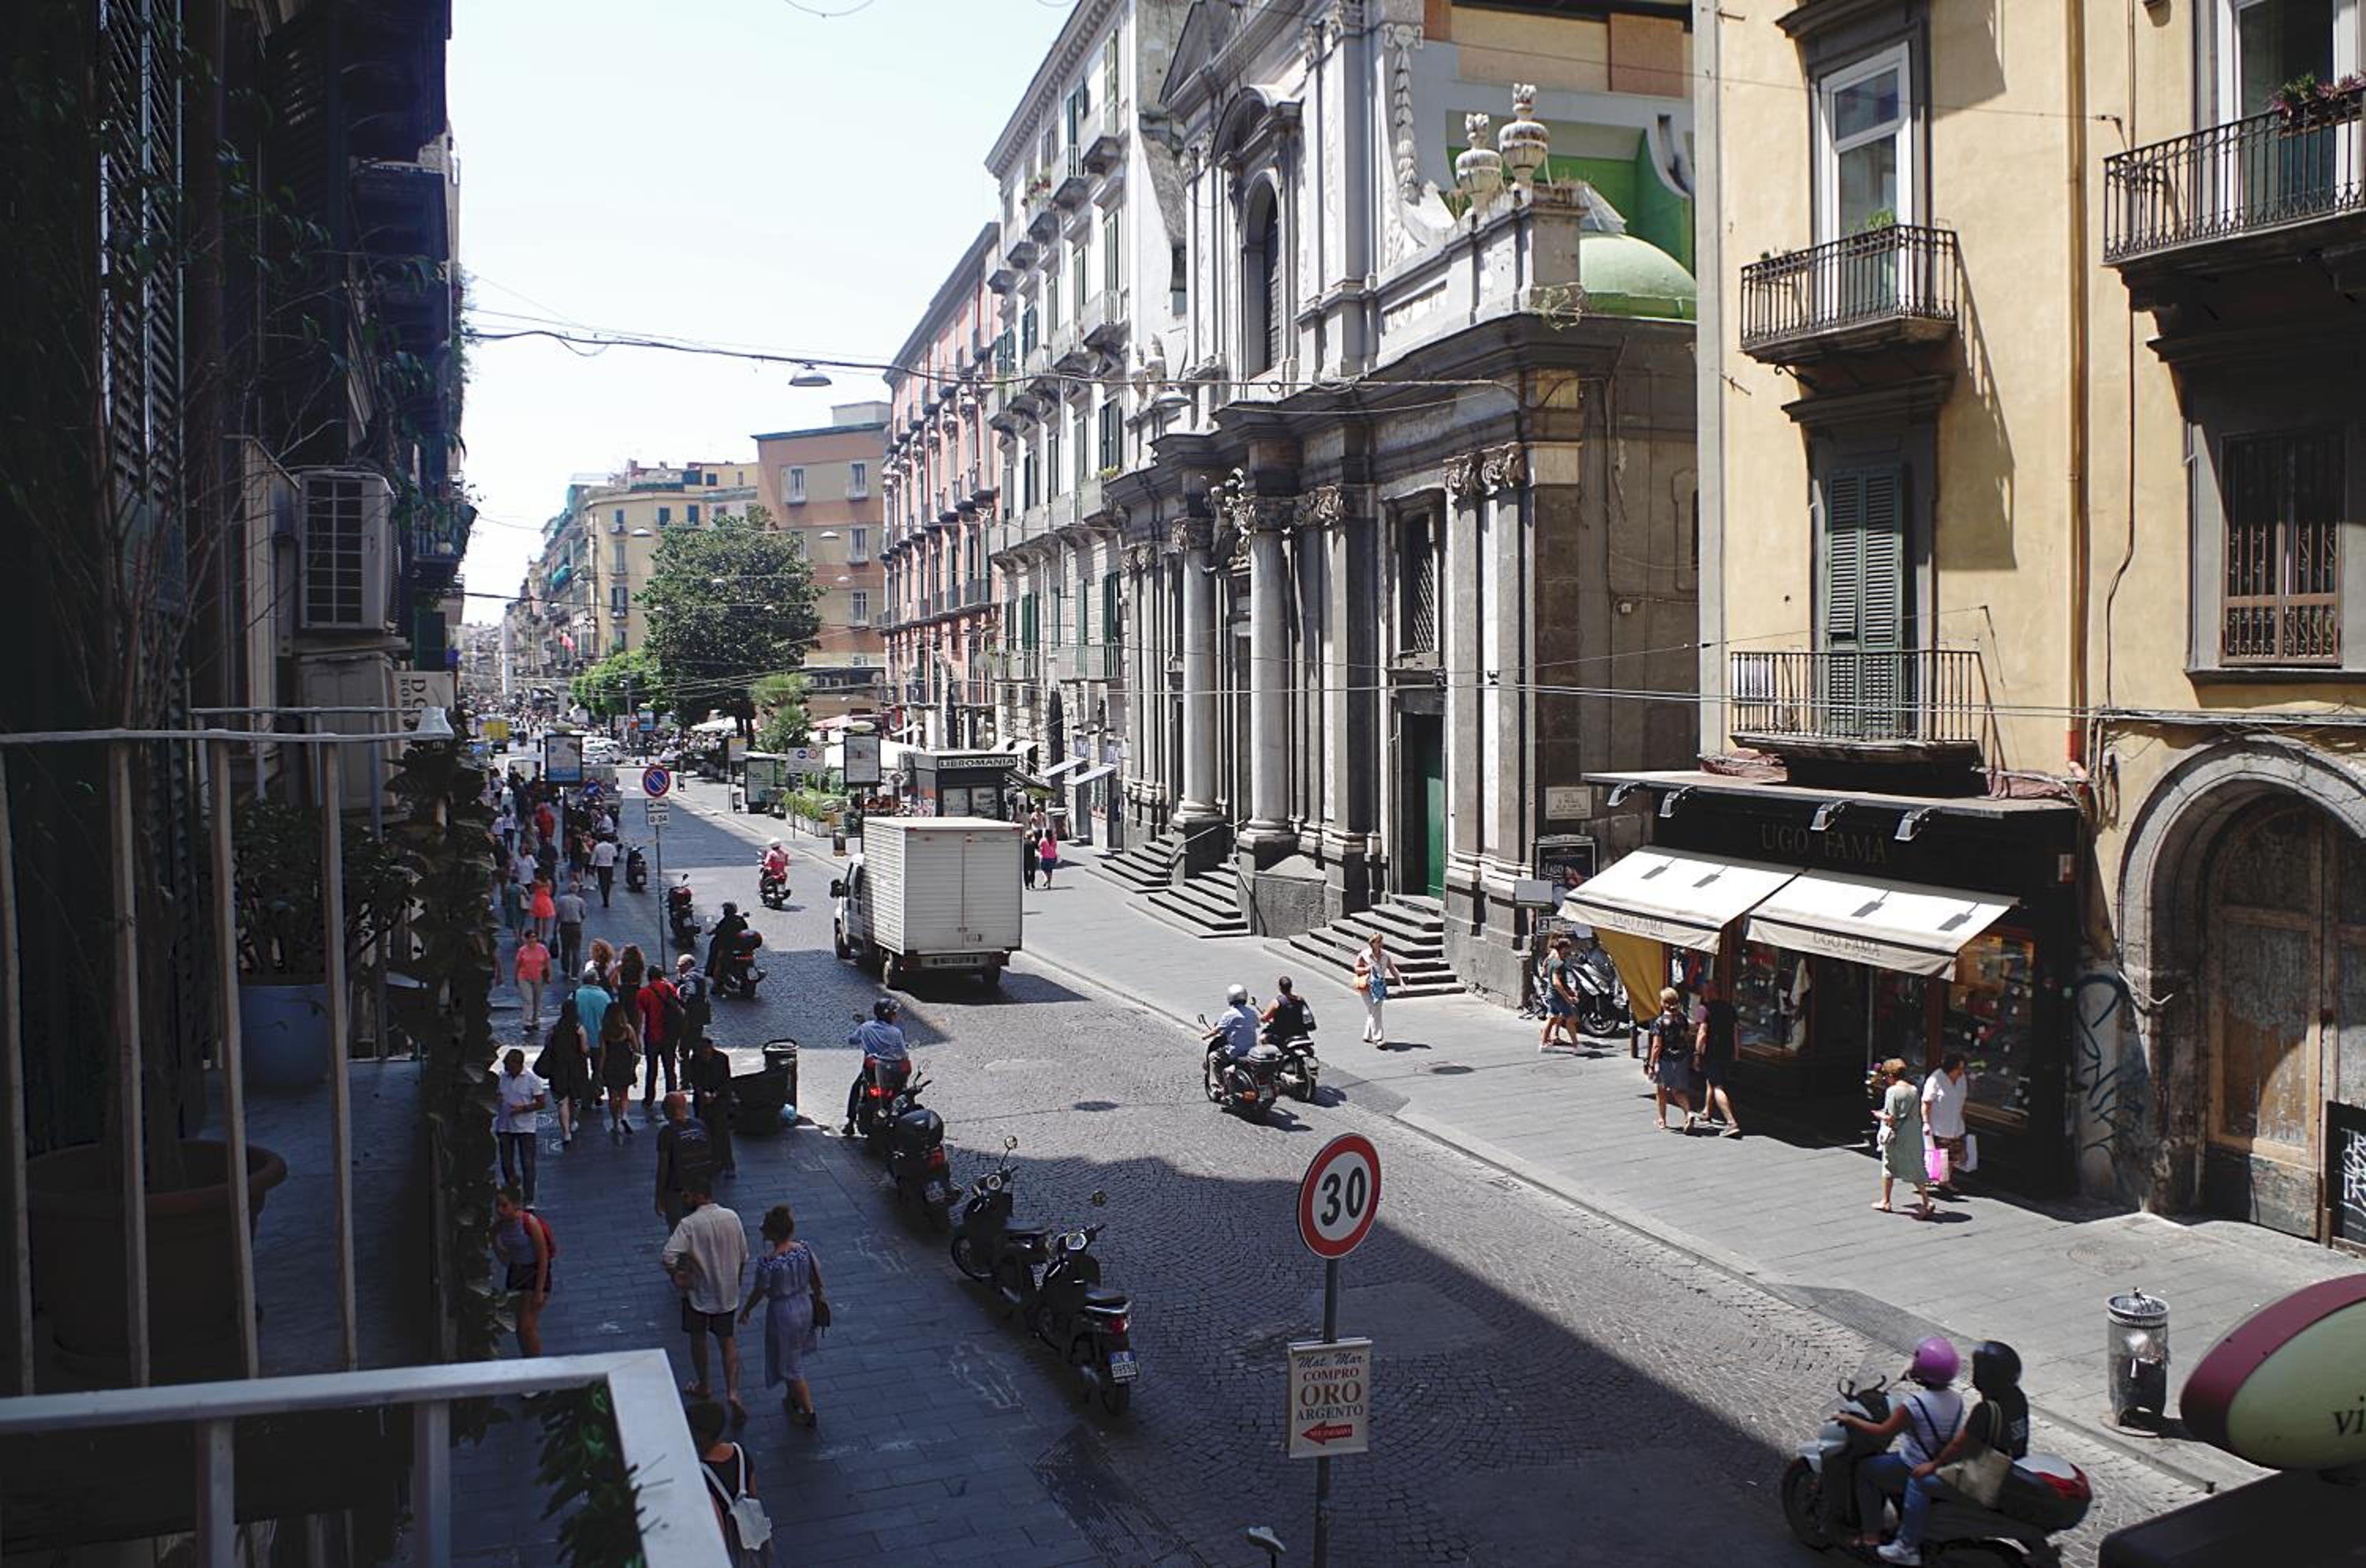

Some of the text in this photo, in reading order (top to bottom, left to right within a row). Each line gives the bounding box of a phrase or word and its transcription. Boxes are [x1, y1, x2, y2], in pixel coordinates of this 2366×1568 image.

[1761, 823, 1809, 853] UGO
[1320, 1167, 1366, 1227] 30
[1304, 1367, 1359, 1382] COMPRO
[1300, 1379, 1362, 1406] ORO
[1296, 1402, 1364, 1421] ARGENTO
